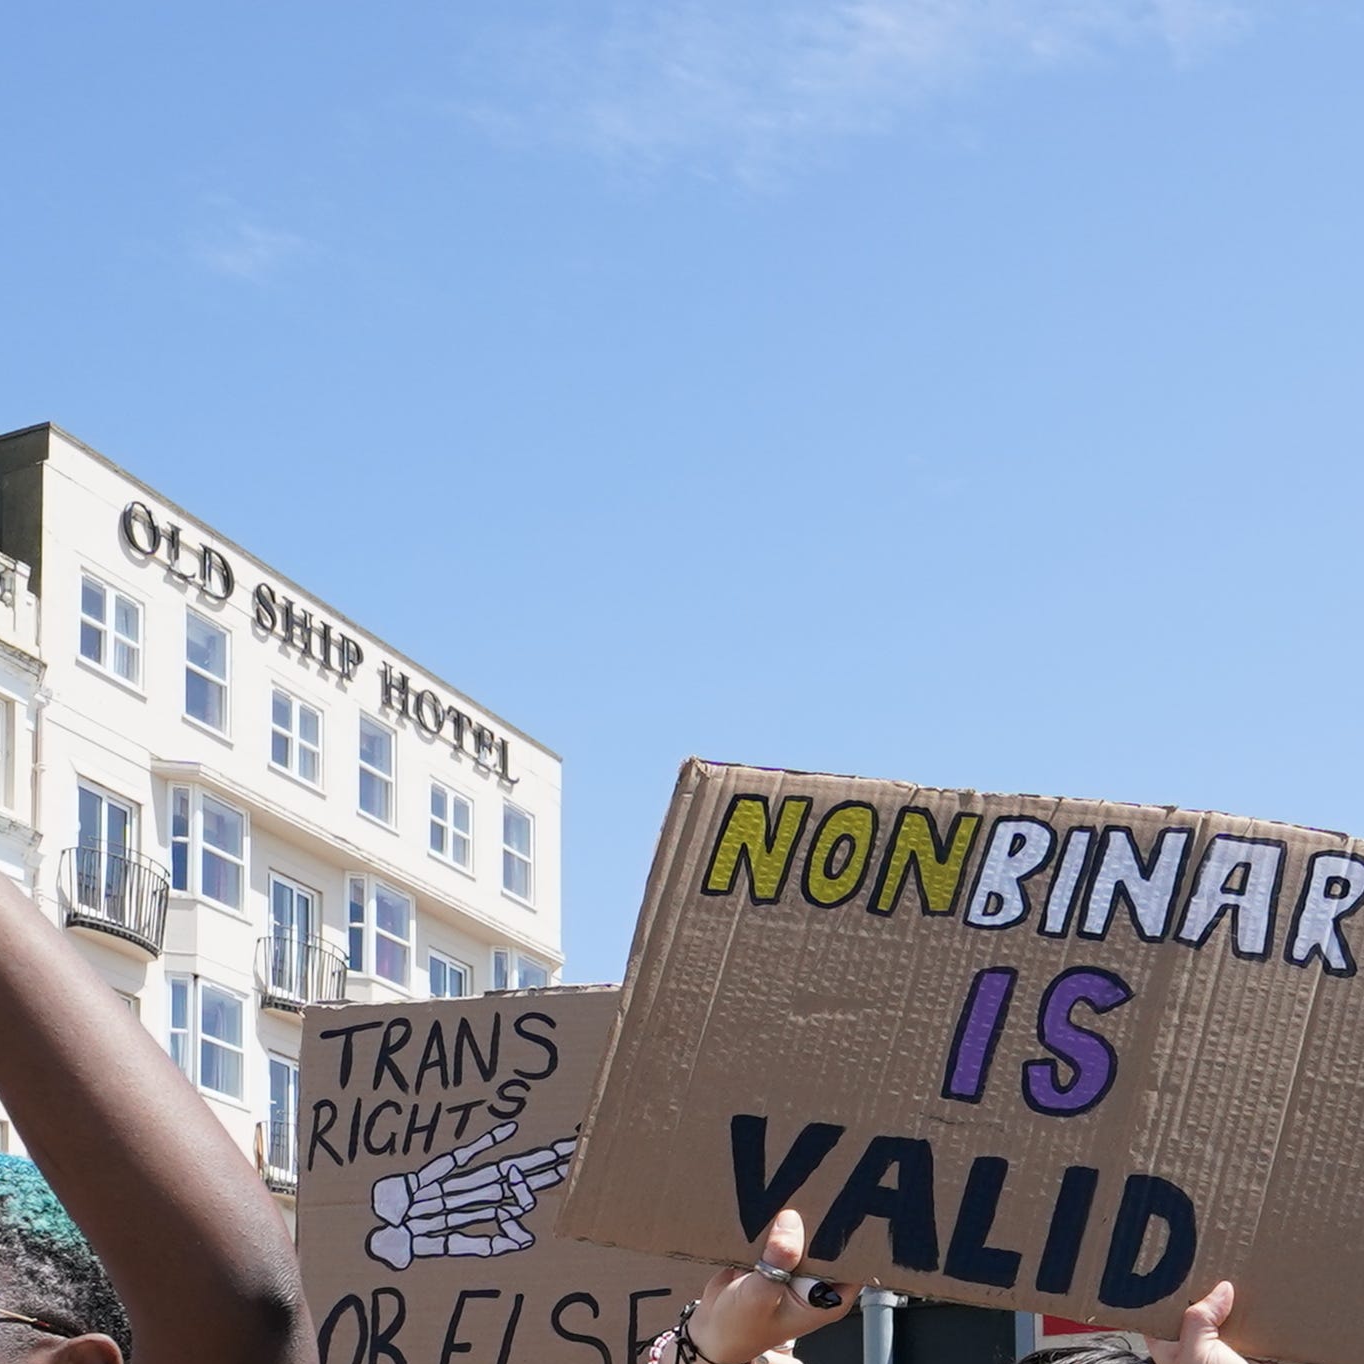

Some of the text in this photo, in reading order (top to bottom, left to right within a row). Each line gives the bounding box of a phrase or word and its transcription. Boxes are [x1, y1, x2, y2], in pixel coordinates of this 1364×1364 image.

[122, 501, 520, 785] OLD SHIP HOTEL
[320, 1012, 559, 1095] TRANS
[942, 966, 1134, 1118] IS
[307, 1079, 531, 1171] RIGHTS
[729, 1114, 1198, 1308] VALID
